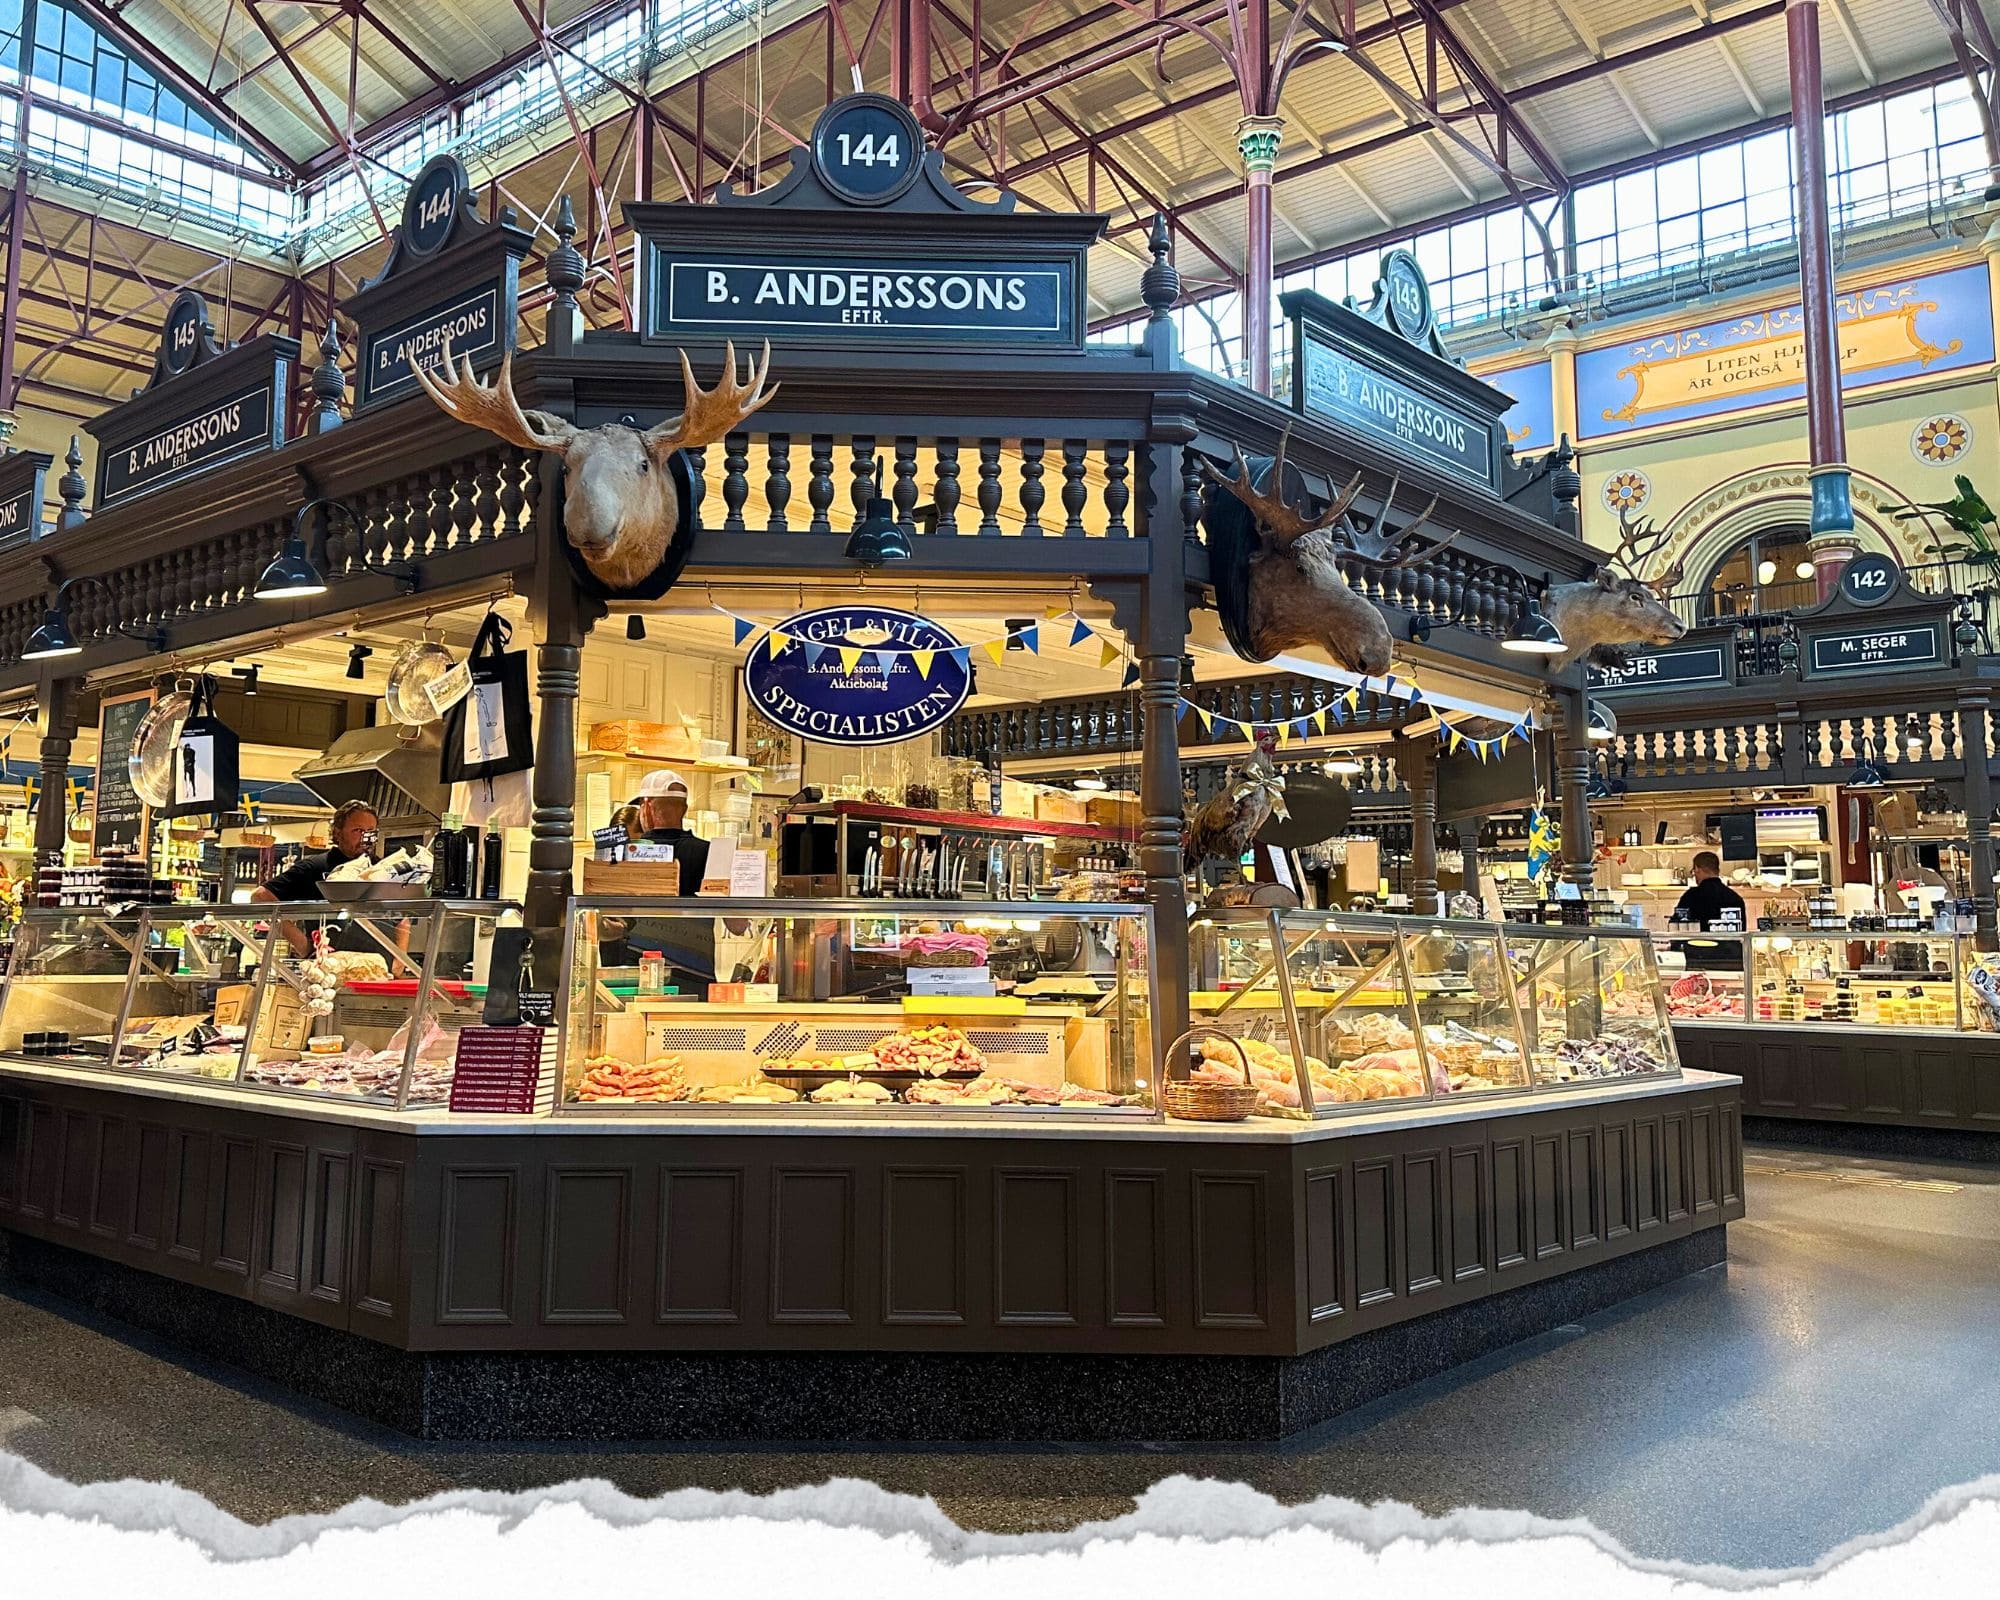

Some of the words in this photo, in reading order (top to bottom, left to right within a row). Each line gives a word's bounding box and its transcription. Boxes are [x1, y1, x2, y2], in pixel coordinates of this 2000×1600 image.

[835, 133, 900, 168] 144
[419, 187, 451, 230] 144
[707, 271, 740, 303] B.
[754, 272, 1027, 311] ANDERSSONS
[1393, 277, 1420, 314] 143
[842, 309, 889, 324] EFTR.
[173, 319, 196, 352] 145
[380, 350, 392, 369] B.
[397, 307, 487, 363] ANDERSSONS
[1688, 378, 1713, 391] ÄR
[1723, 360, 1783, 383] OCKSÅ
[1338, 368, 1354, 401] B.
[1359, 380, 1466, 452] ANDERSSONS
[128, 450, 141, 475] B.
[144, 405, 241, 468] ANDERSSONS
[1396, 422, 1416, 442] EFTR.
[172, 454, 190, 468] EFTR.
[1851, 569, 1887, 589] 142
[881, 618, 943, 650] VILT
[1840, 640, 1858, 653] M.
[1862, 635, 1907, 651] SEGER
[1600, 658, 1658, 679] SEGER
[1861, 650, 1888, 660] EFTR.
[829, 678, 889, 691] Aktiebolag
[762, 682, 953, 737] SPECIALISTEN
